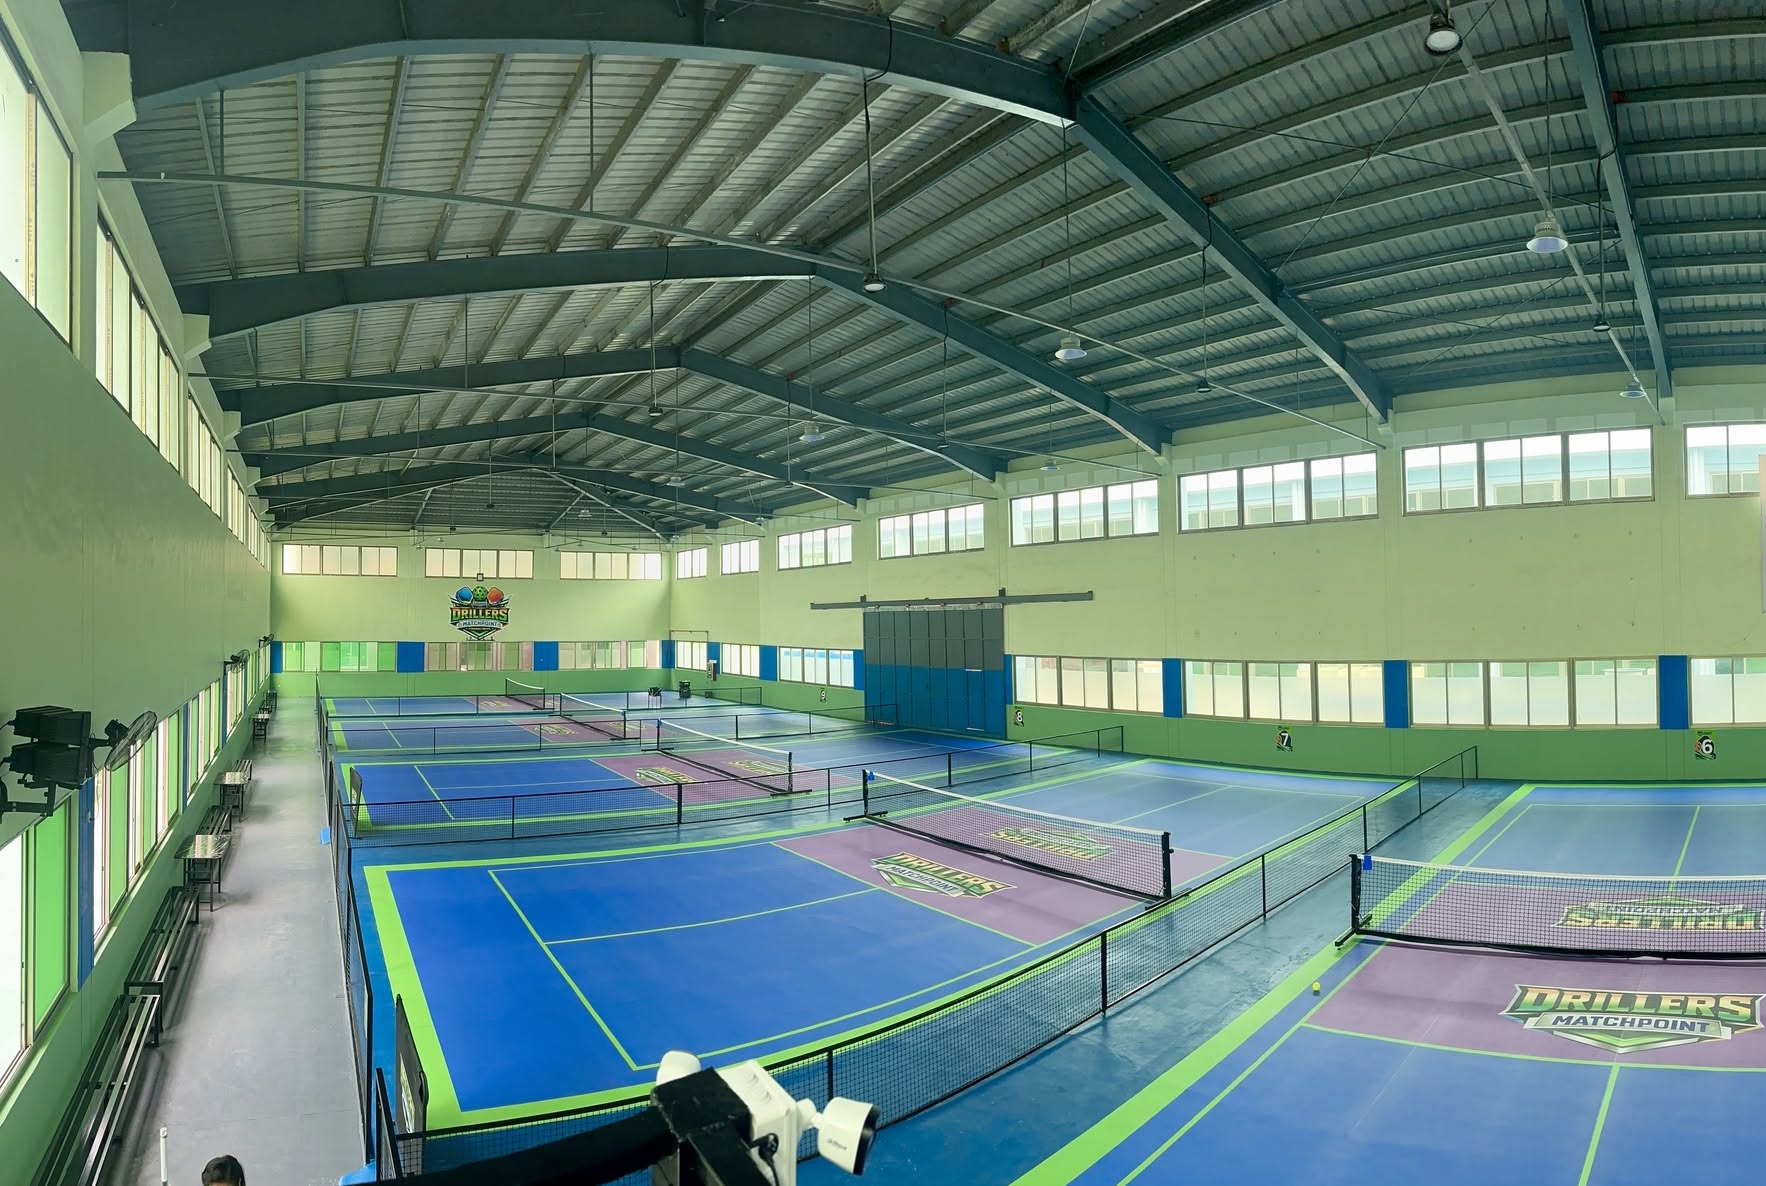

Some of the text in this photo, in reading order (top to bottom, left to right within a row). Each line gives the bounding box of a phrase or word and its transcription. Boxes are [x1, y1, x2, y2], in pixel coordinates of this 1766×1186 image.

[452, 608, 508, 621] DRILLERS
[1016, 711, 1023, 722] 8
[1280, 732, 1289, 746] 7
[1702, 738, 1713, 754] 6
[888, 865, 959, 894] MATCHPOINT
[890, 854, 1005, 897] DRILLERS
[1514, 987, 1753, 1022] DRILLERS
[1550, 1014, 1711, 1034] MATCHPOINT
